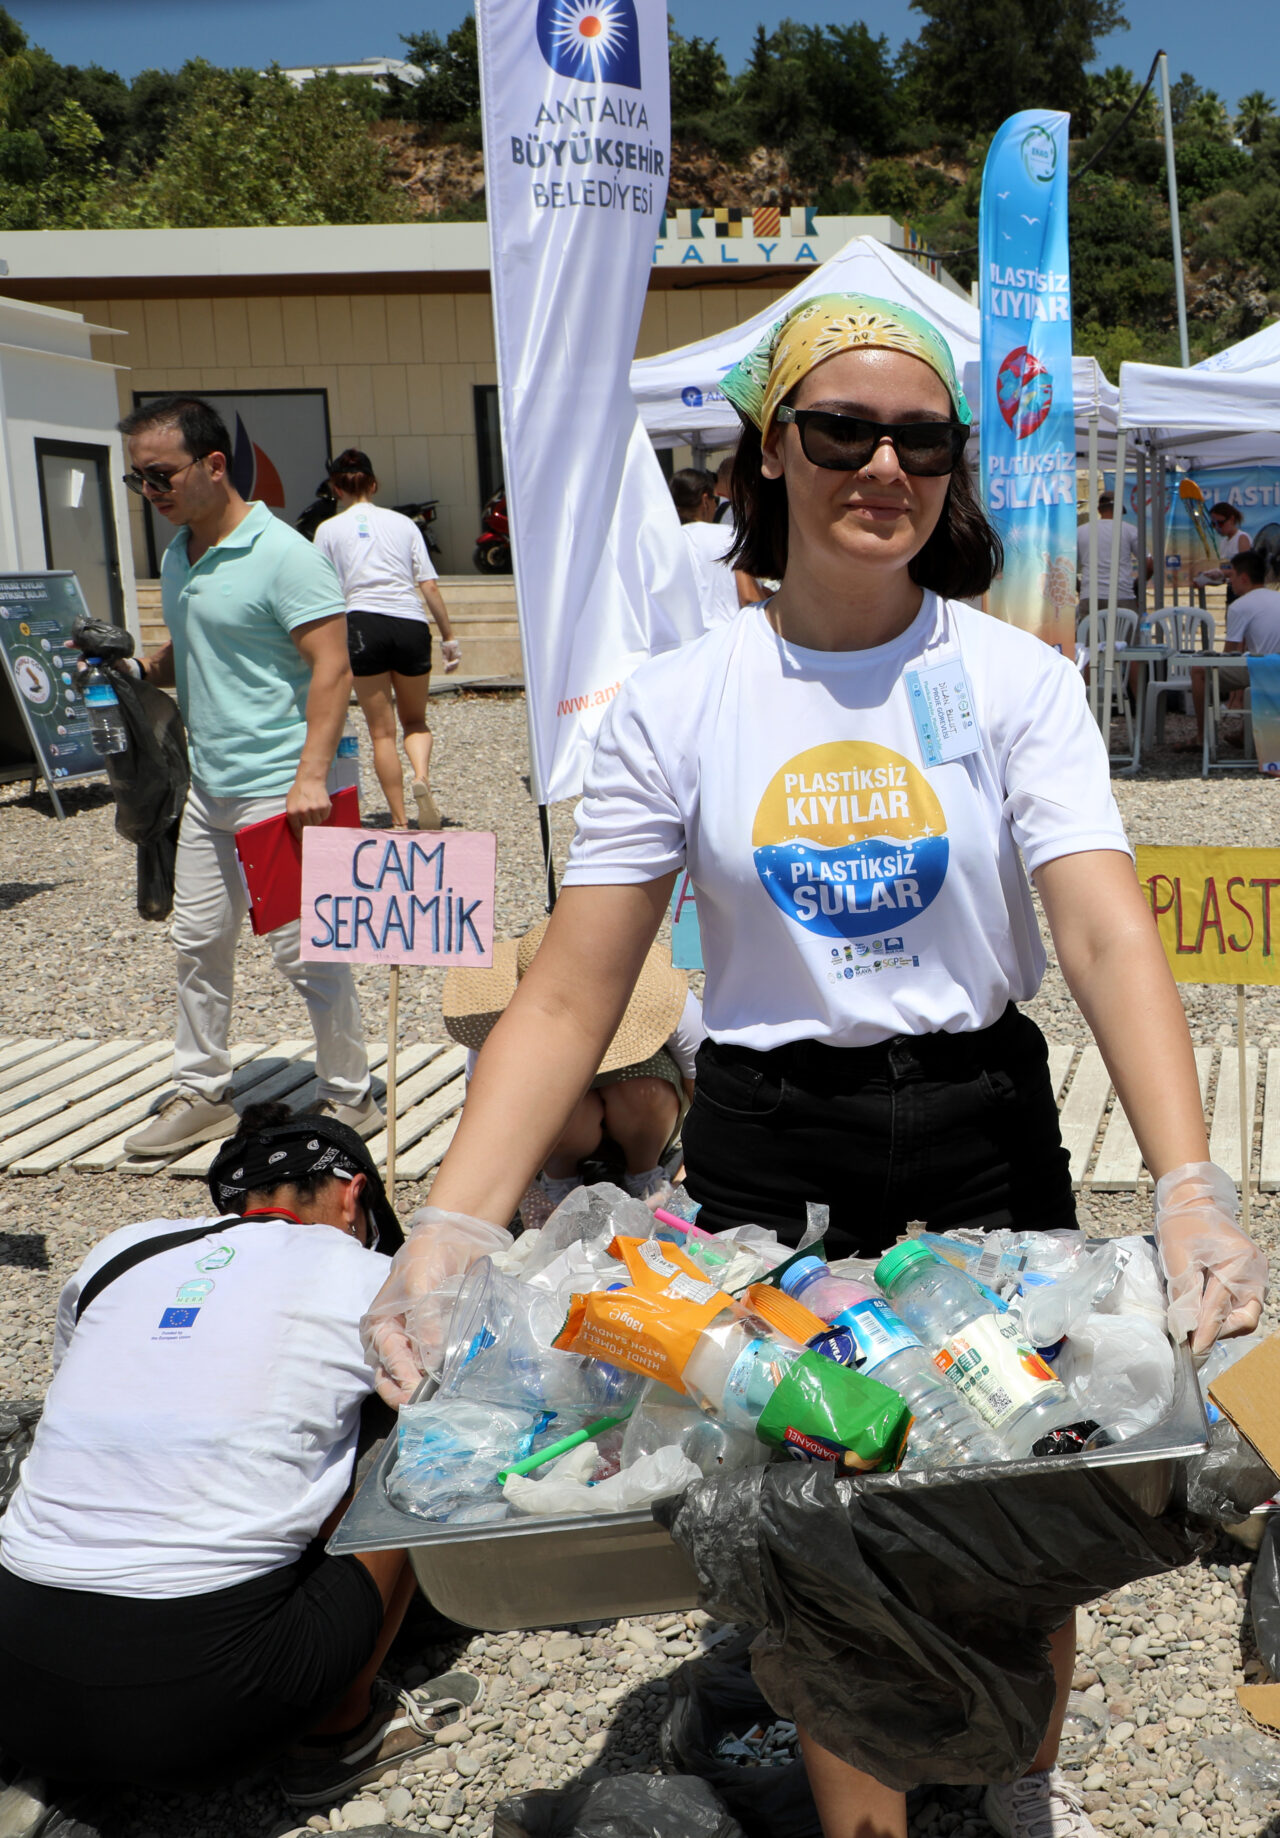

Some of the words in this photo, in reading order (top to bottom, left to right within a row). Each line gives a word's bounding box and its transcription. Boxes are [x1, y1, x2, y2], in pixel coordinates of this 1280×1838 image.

[535, 96, 649, 131] ANTALYA
[511, 130, 665, 177] BÜYÜKŞEHİR
[532, 175, 653, 215] BELEDİYESİ
[932, 687, 942, 707] PROJE
[938, 682, 951, 706] DİLAN
[784, 762, 907, 794] PLASTİKSİZ
[786, 789, 911, 827] KIYILAR
[352, 839, 445, 892] CAM
[790, 849, 918, 885] PLASTİKSİZ
[793, 877, 923, 922] SULAR
[311, 886, 486, 955] SERAMİK
[626, 1350, 661, 1370] HİNDİ
[631, 1342, 668, 1361] BATON
[828, 1337, 842, 1362] NIVEA
[788, 1428, 837, 1461] DARDANEL
